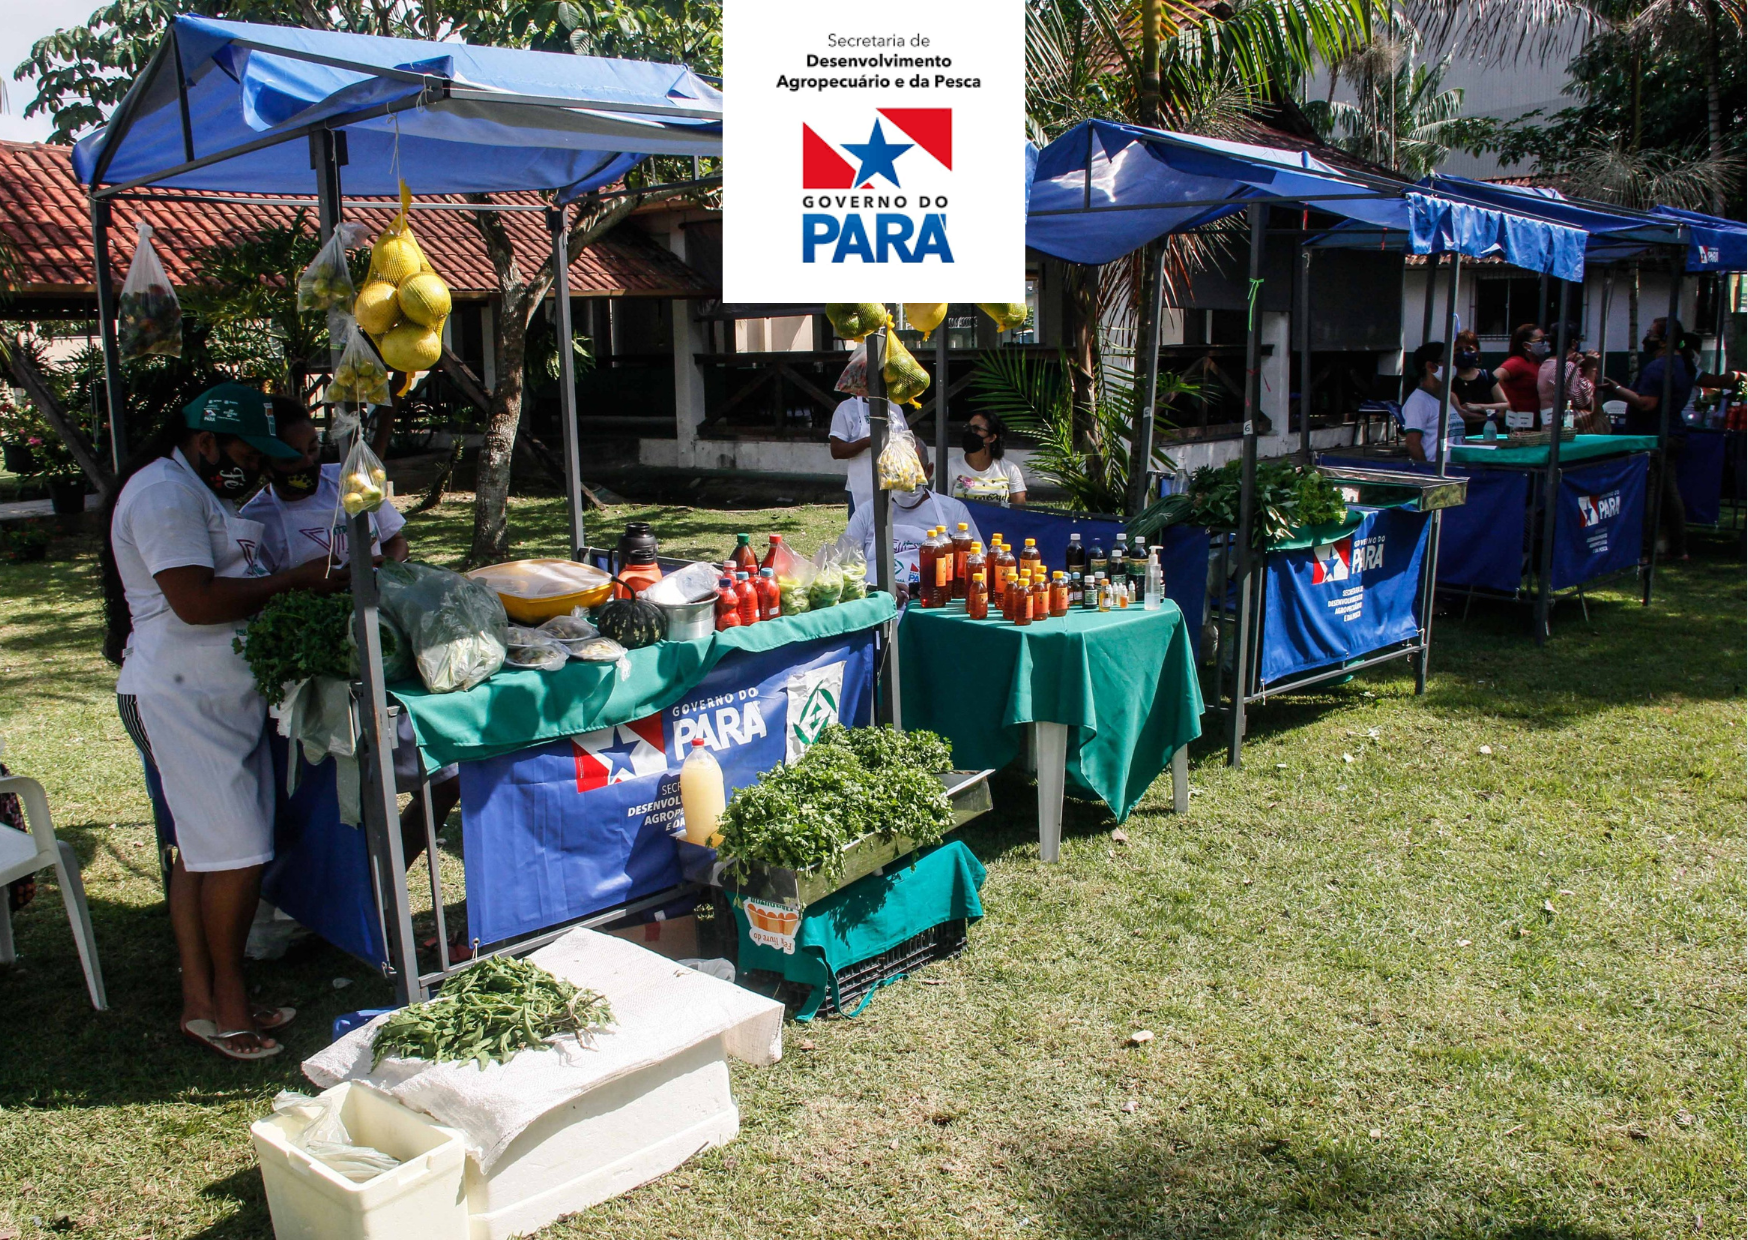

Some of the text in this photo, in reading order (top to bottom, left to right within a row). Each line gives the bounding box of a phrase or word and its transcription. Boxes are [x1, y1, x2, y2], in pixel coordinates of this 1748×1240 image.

[672, 687, 759, 717] GOVERNO DO
[627, 796, 683, 817] DESENVOL
[665, 822, 672, 831] E
